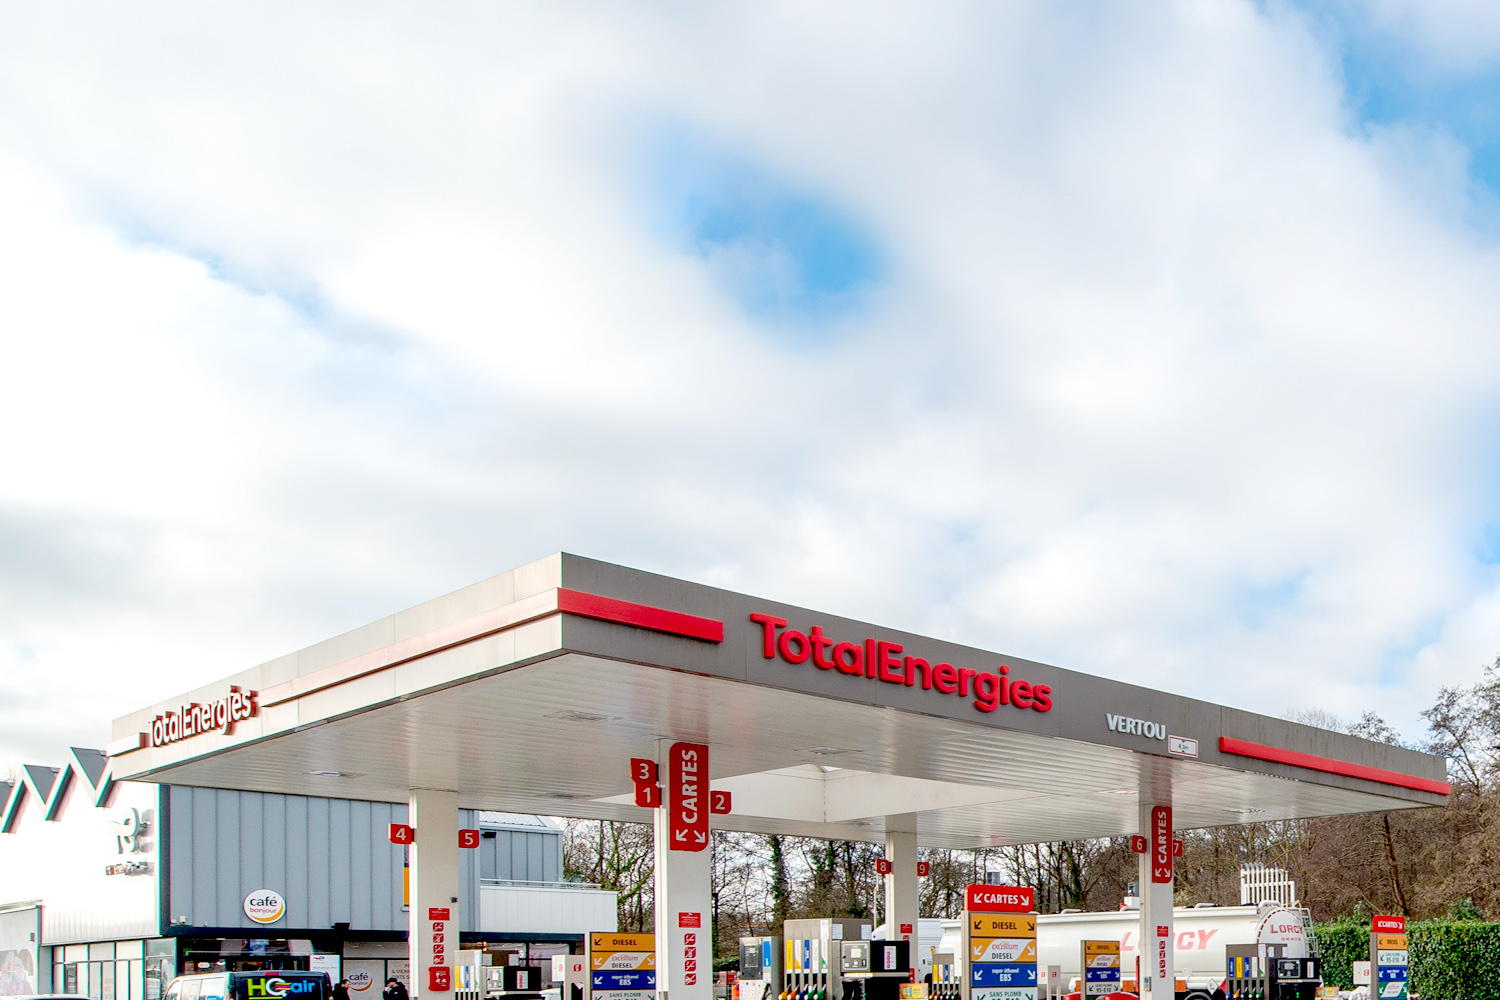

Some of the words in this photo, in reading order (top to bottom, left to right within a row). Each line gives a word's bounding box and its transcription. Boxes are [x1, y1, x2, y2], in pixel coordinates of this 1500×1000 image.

[749, 611, 1053, 714] TotalEnergies
[148, 684, 260, 748] TotalEnergies
[1106, 713, 1166, 741] VERTOU
[639, 763, 650, 780] 3
[682, 749, 698, 824] CARTES
[643, 787, 651, 804] 1
[715, 794, 726, 811] 2
[395, 827, 406, 841] 4
[464, 832, 474, 846] 5
[1158, 811, 1167, 864] CARTES
[1137, 838, 1143, 850] 6
[1173, 842, 1179, 854] 7
[880, 861, 886, 872] 8
[920, 864, 926, 875] 9
[249, 896, 277, 907] café
[984, 893, 1018, 904] CARTES
[992, 921, 1018, 930] DIESEL
[991, 952, 1013, 960] DIESEL
[348, 972, 369, 981] café
[999, 973, 1013, 982] E85
